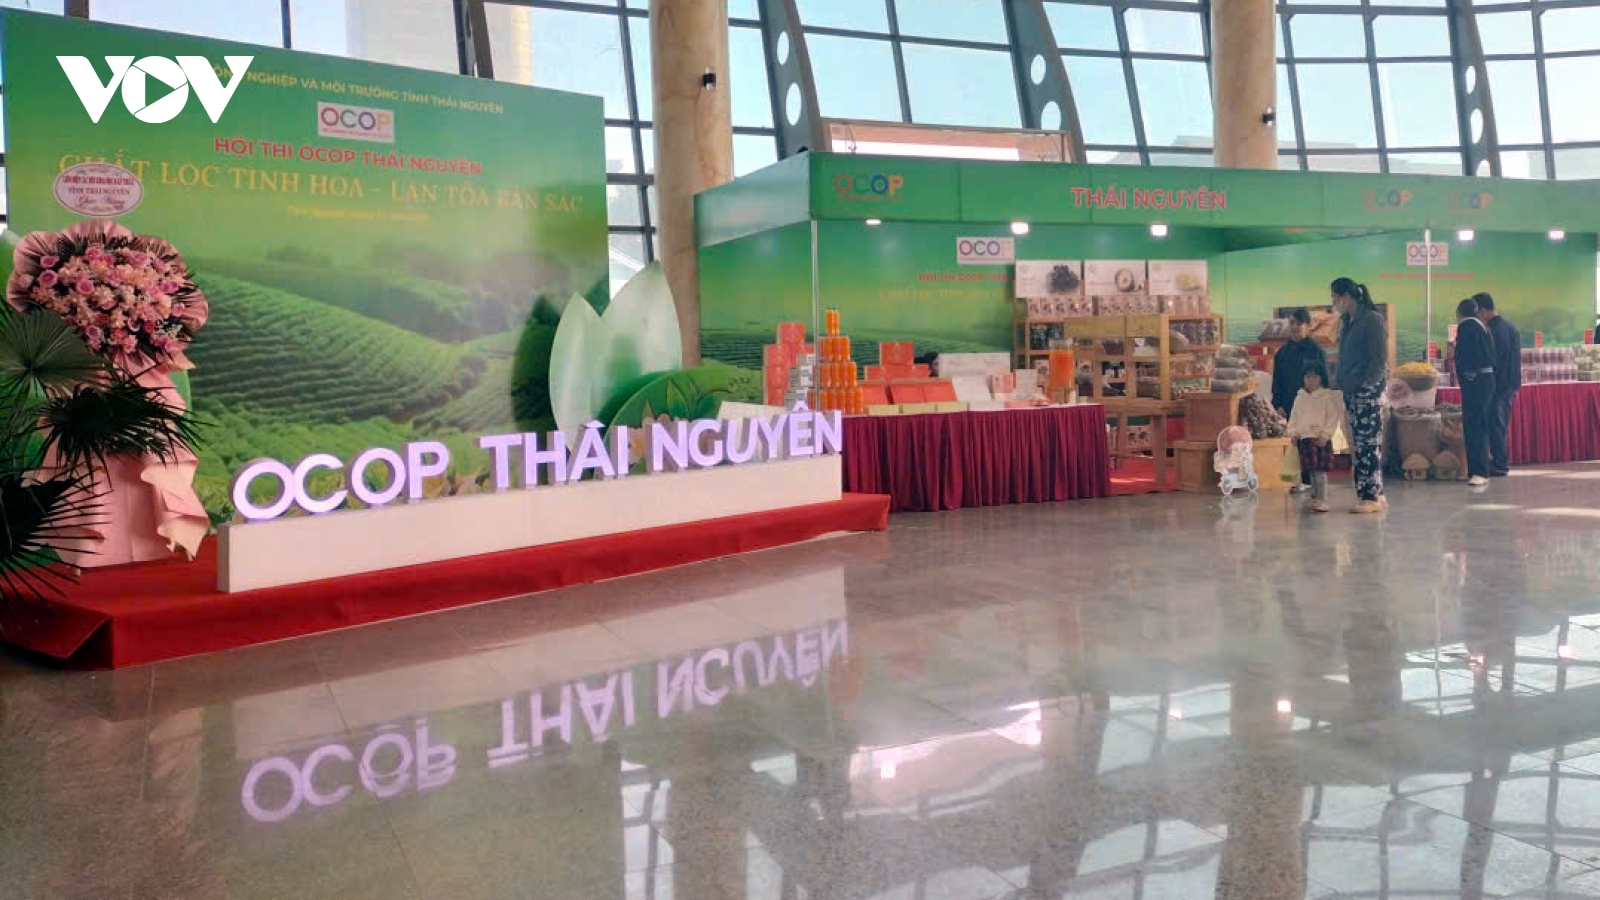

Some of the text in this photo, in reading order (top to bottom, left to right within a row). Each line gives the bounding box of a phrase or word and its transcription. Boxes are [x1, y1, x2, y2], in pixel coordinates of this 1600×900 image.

[321, 107, 392, 131] OCOP
[214, 136, 482, 176] HỘI THI OCOP THÁI NGUYÊN
[228, 167, 300, 193] TINH
[309, 173, 363, 198] HOA
[391, 179, 438, 201] LAN
[834, 173, 904, 196] OCOP
[1070, 184, 1227, 210] THÁI NGUYÊN
[230, 441, 450, 522] OCOP
[649, 398, 843, 472] NGUYÊN
